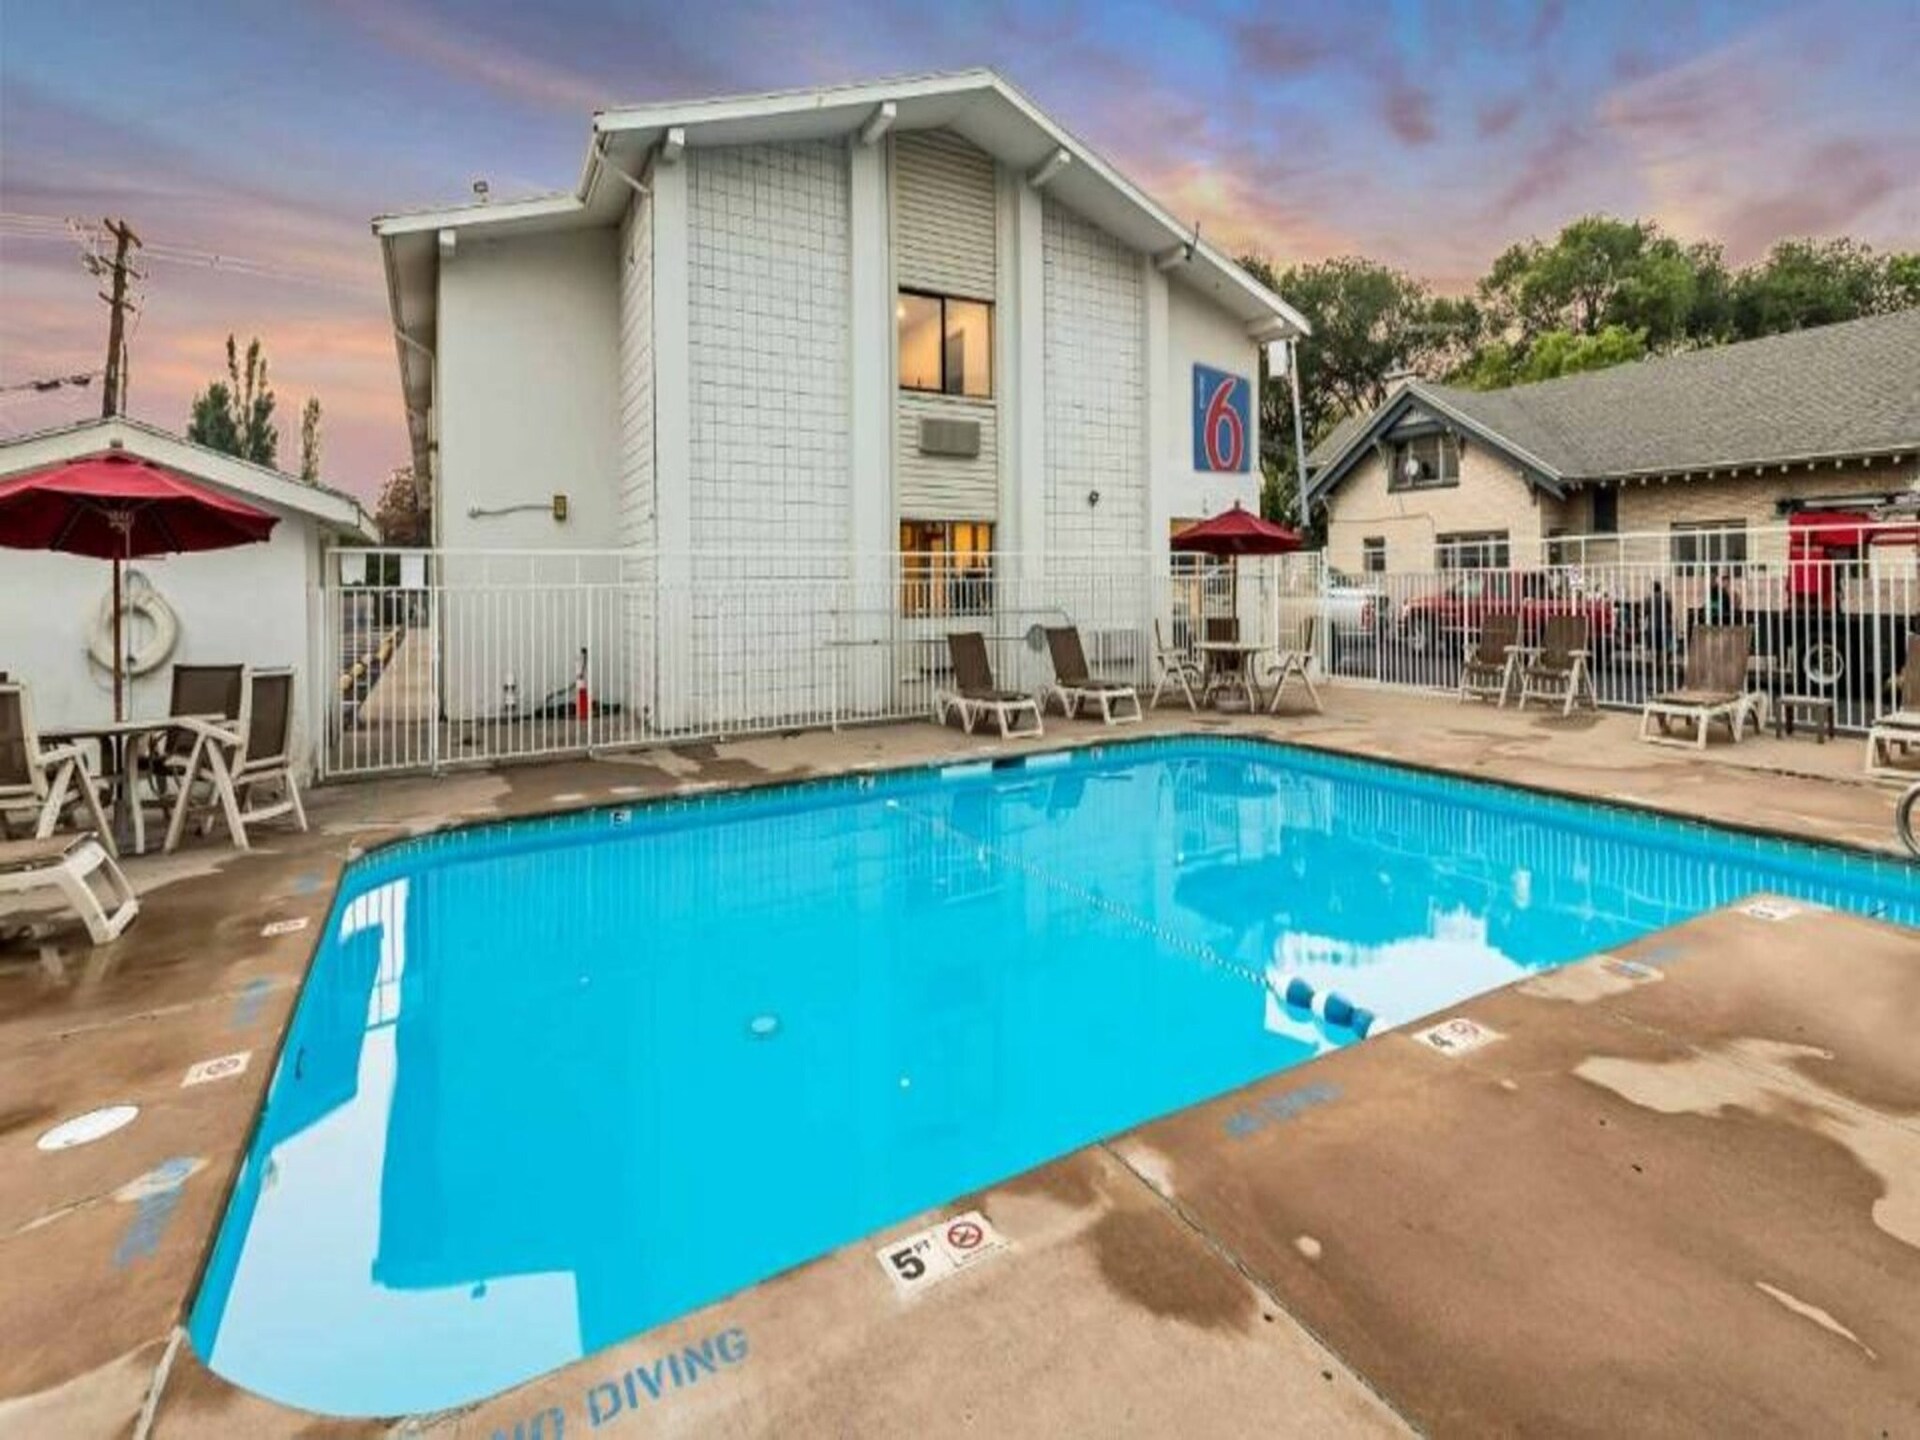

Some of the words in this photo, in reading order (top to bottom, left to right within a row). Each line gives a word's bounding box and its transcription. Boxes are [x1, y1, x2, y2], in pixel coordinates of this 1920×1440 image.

[1204, 376, 1245, 473] 6
[890, 1247, 926, 1280] 5
[587, 1327, 748, 1428] DIVING
